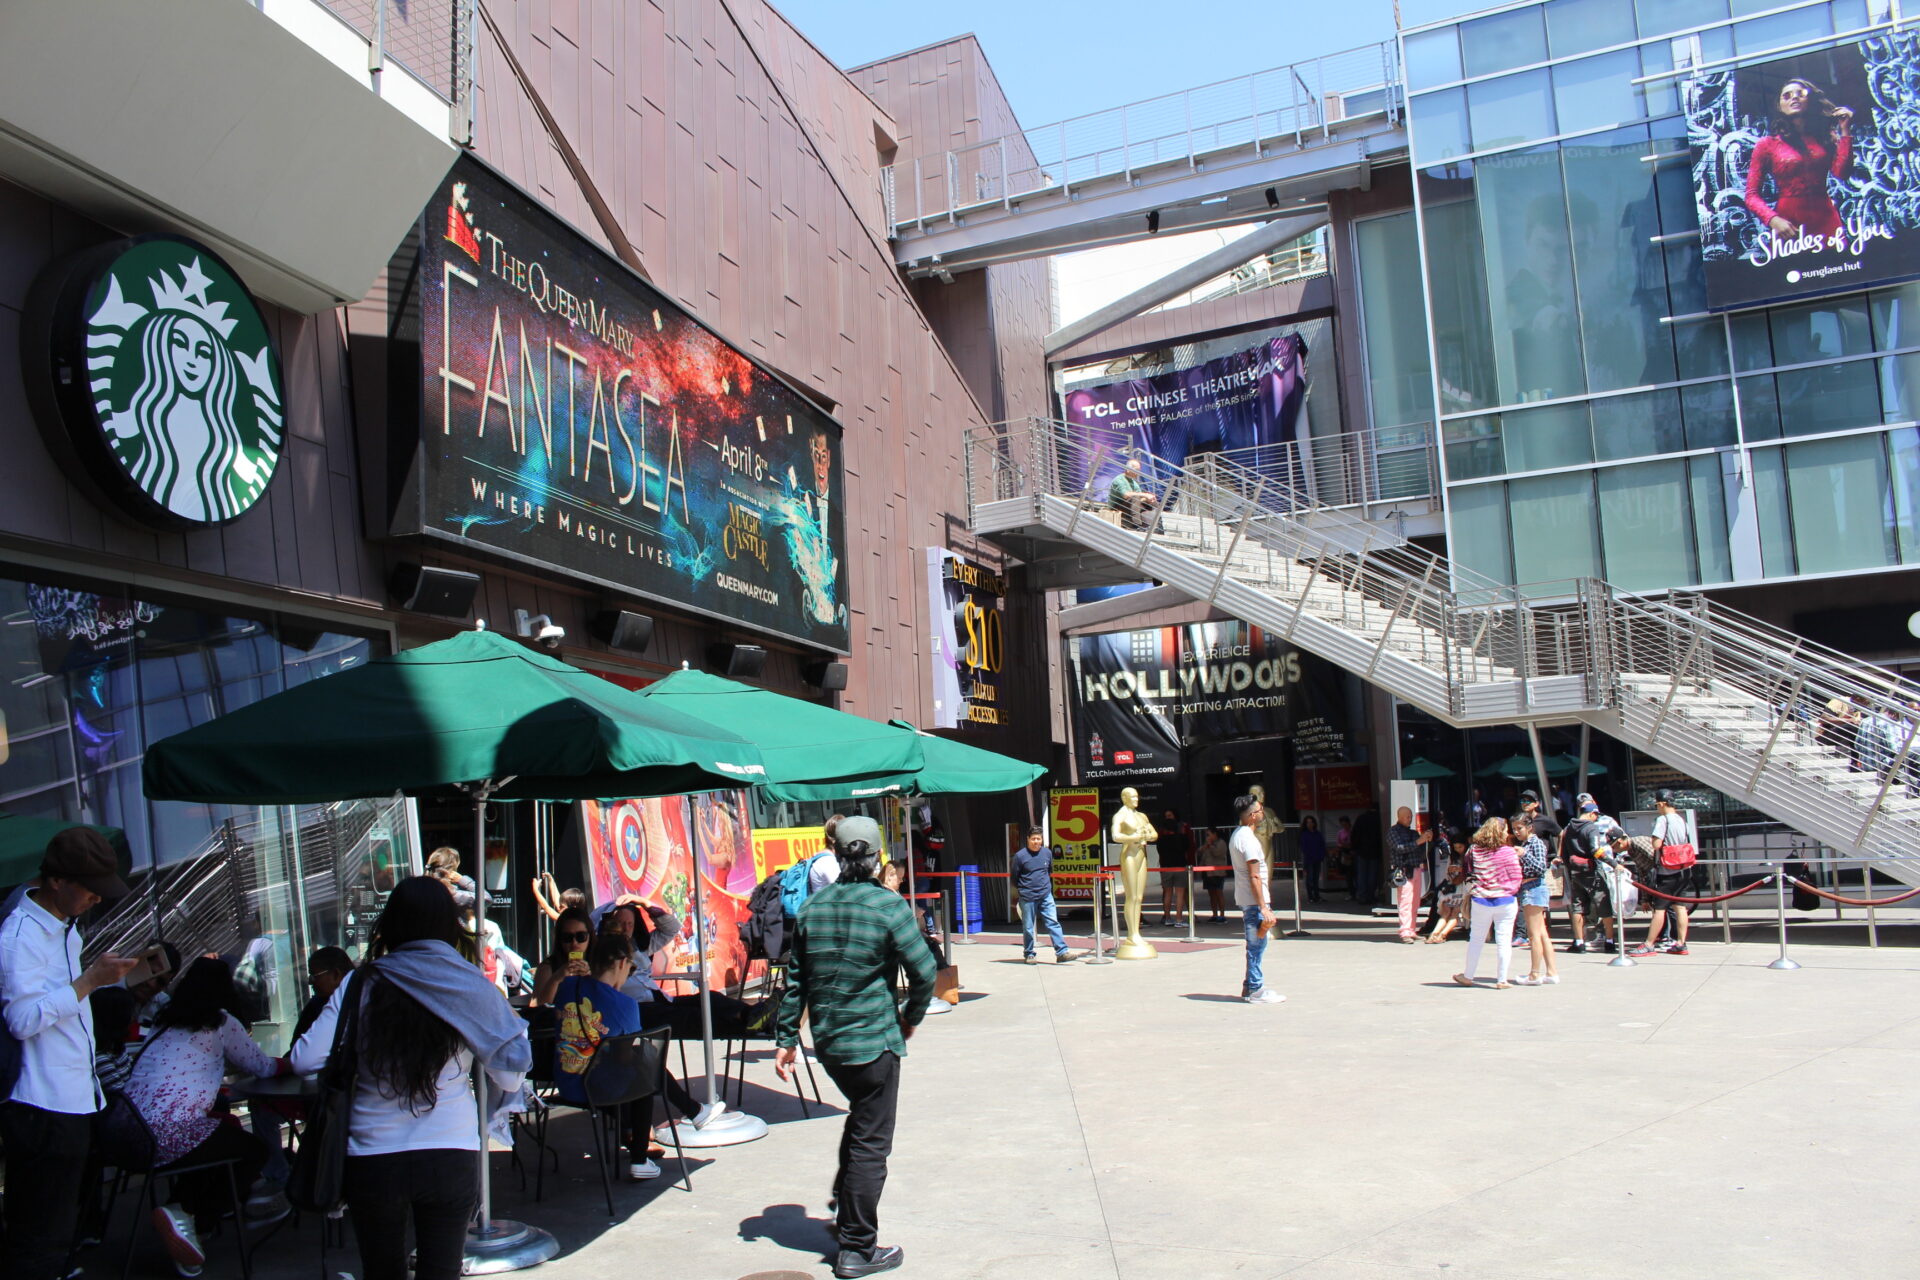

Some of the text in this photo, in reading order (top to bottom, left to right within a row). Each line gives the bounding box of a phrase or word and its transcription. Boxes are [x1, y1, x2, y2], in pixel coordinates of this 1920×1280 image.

[1750, 217, 1893, 267] Shades of You
[1801, 261, 1861, 280] sunglass hut
[486, 231, 634, 360] THE QUEEN MARY
[439, 261, 690, 525] FANTASEA
[1081, 402, 1120, 419] TCL
[1126, 388, 1189, 412] CHINESE
[1192, 371, 1249, 397] THEATRE
[1110, 420, 1126, 431] The
[1128, 415, 1156, 428] MOVIE
[1160, 408, 1193, 423] PALACE
[1195, 405, 1203, 415] of
[1205, 402, 1216, 412] the
[1216, 395, 1240, 408] STARS
[721, 434, 752, 477] April
[471, 477, 673, 569] WHERE MAGIC LIVES
[728, 501, 763, 537] MAGIC
[723, 524, 769, 573] CASTLE
[716, 572, 779, 606] QUEENMARY.COM
[964, 594, 1004, 674] $10
[1183, 645, 1250, 663] EXPERIENCE
[1134, 704, 1167, 715] MOST
[1173, 699, 1221, 715] EXCITING
[1055, 876, 1094, 885] SALE
